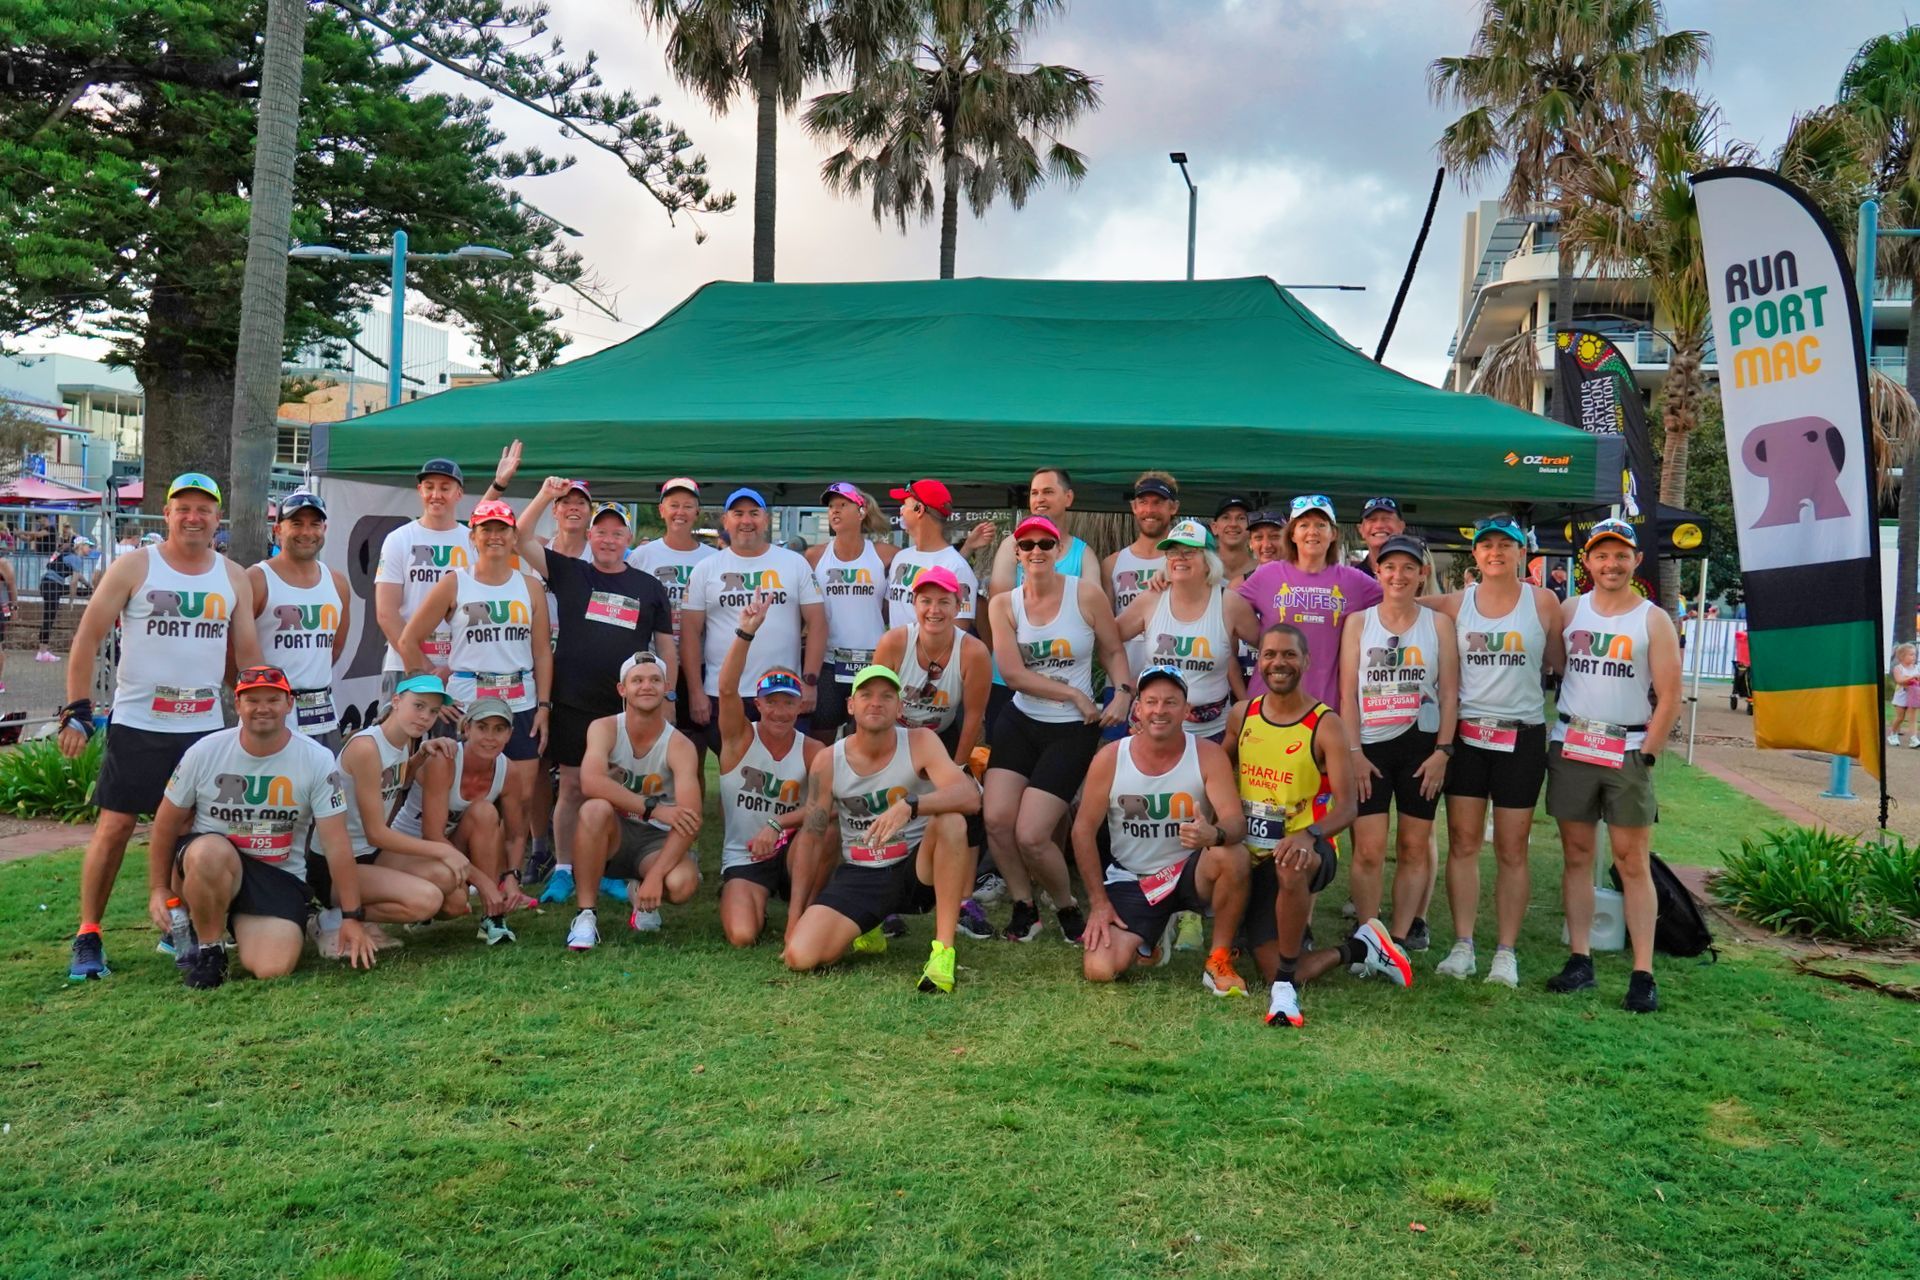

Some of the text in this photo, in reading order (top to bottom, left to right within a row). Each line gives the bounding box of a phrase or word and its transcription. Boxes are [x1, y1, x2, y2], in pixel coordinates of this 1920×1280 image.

[1725, 250, 1799, 303] RUN
[1728, 285, 1828, 346] PORT
[1733, 334, 1822, 389] MAC
[1590, 378, 1608, 435] RATHON
[1523, 455, 1570, 465] OZtrail
[410, 544, 468, 567] RUN
[410, 568, 442, 582] PORT
[720, 569, 784, 592] RUN
[826, 568, 872, 584] RUN
[826, 584, 874, 596] PORT MAC
[146, 590, 226, 620] RUN
[719, 594, 754, 608] PORT
[273, 604, 338, 631] RUN
[462, 600, 530, 626] RUN
[147, 620, 225, 639] PORT MAC
[466, 626, 530, 644] PORT MAC
[274, 634, 334, 650] PORT MA
[1154, 633, 1216, 659] RUN
[1466, 631, 1527, 652] RUN
[1568, 629, 1632, 661] RUN
[1186, 660, 1215, 672] MAC
[1467, 654, 1526, 666] PORT MAC
[1570, 658, 1635, 678] PORT MAC
[1367, 668, 1426, 682] PORT MAC
[174, 702, 196, 713] 934
[1368, 696, 1414, 706] SPEEDY SUSAN
[1584, 734, 1606, 746] PARTO
[1240, 763, 1294, 784] CHARLIE
[215, 773, 299, 806] RUN
[740, 766, 800, 802] RUN
[1248, 778, 1278, 791] MAHER
[736, 794, 772, 812] PORT
[1118, 792, 1194, 820] RUN
[210, 806, 299, 822] PORT MAC
[1122, 822, 1160, 838] PORT
[1247, 816, 1268, 838] 166
[250, 838, 272, 848] 795
